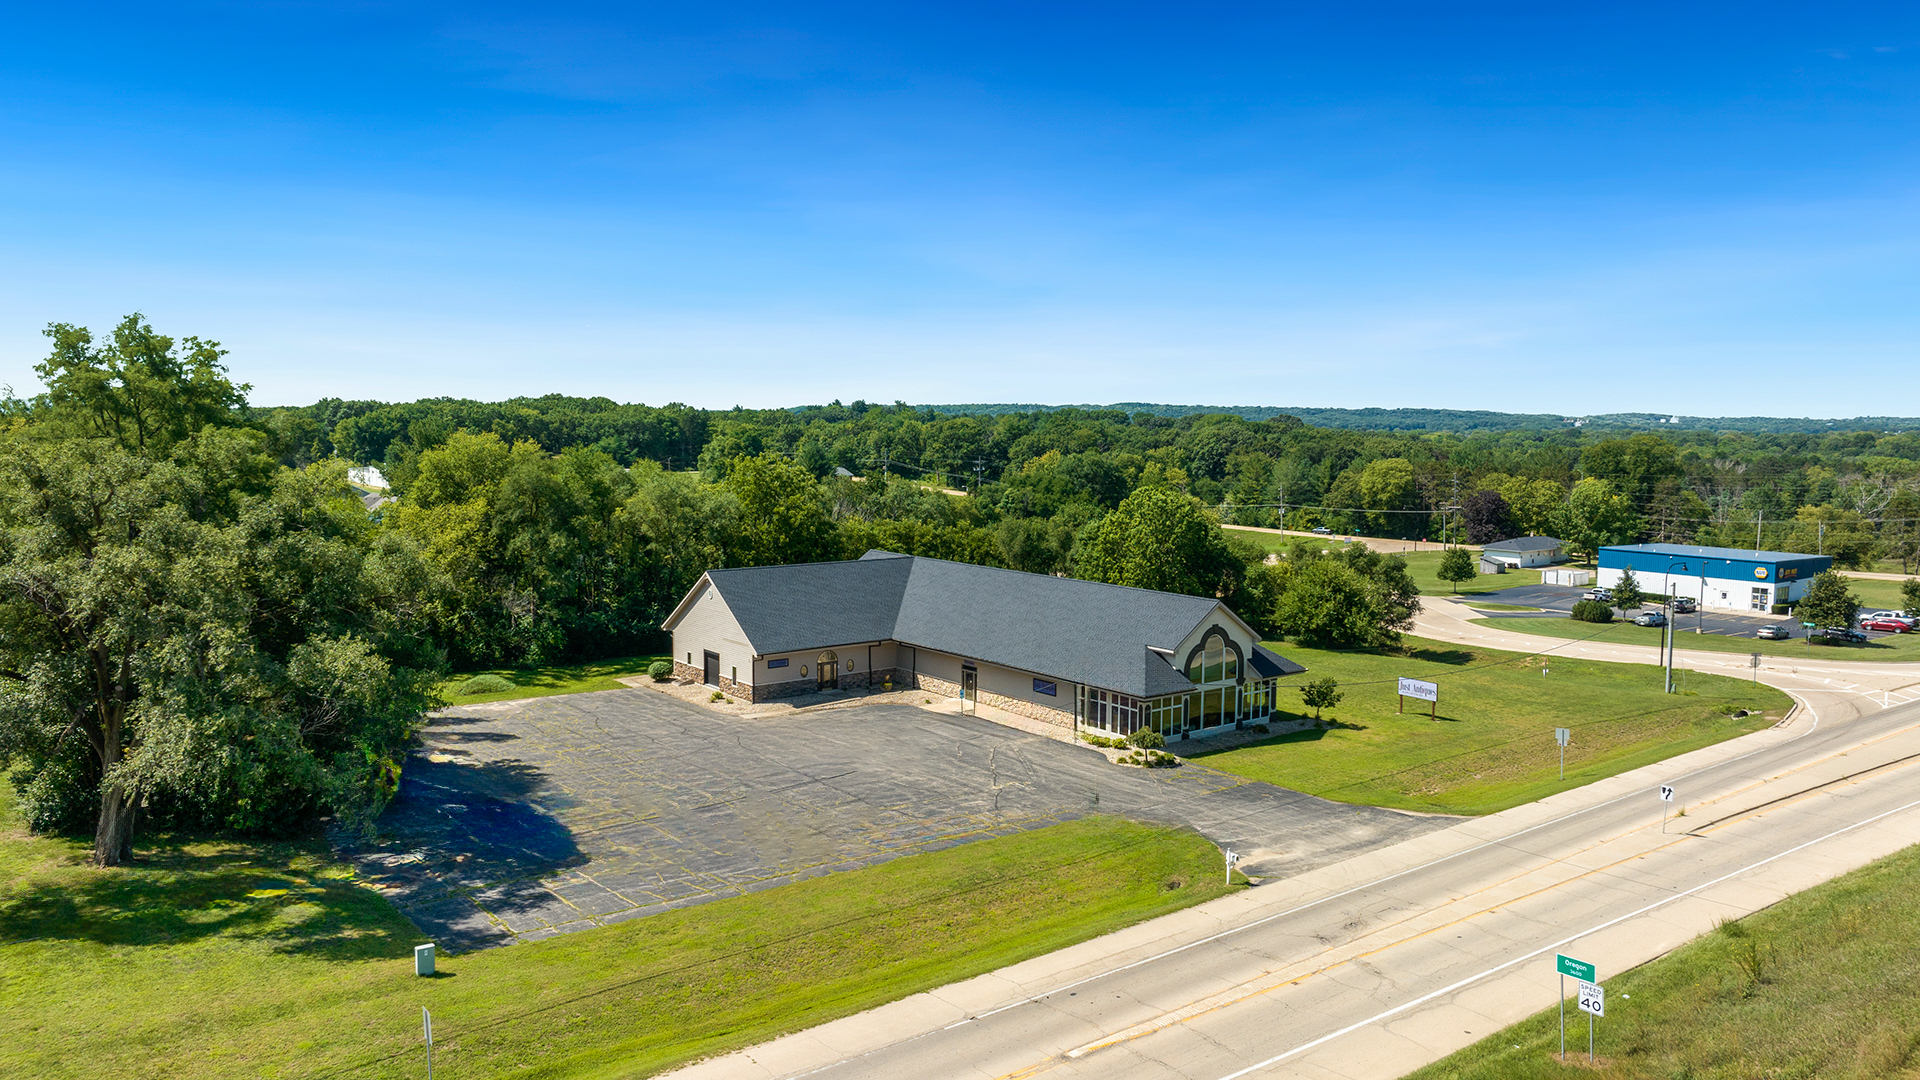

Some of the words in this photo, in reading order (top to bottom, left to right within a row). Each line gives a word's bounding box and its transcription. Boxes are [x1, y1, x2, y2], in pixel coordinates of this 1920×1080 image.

[1399, 681, 1411, 691] Just
[1412, 684, 1437, 697] Antiques
[1564, 959, 1587, 972] Oregon
[1581, 984, 1602, 995] SPEED
[1583, 990, 1599, 1000] LIMIT
[1581, 998, 1601, 1012] 40
